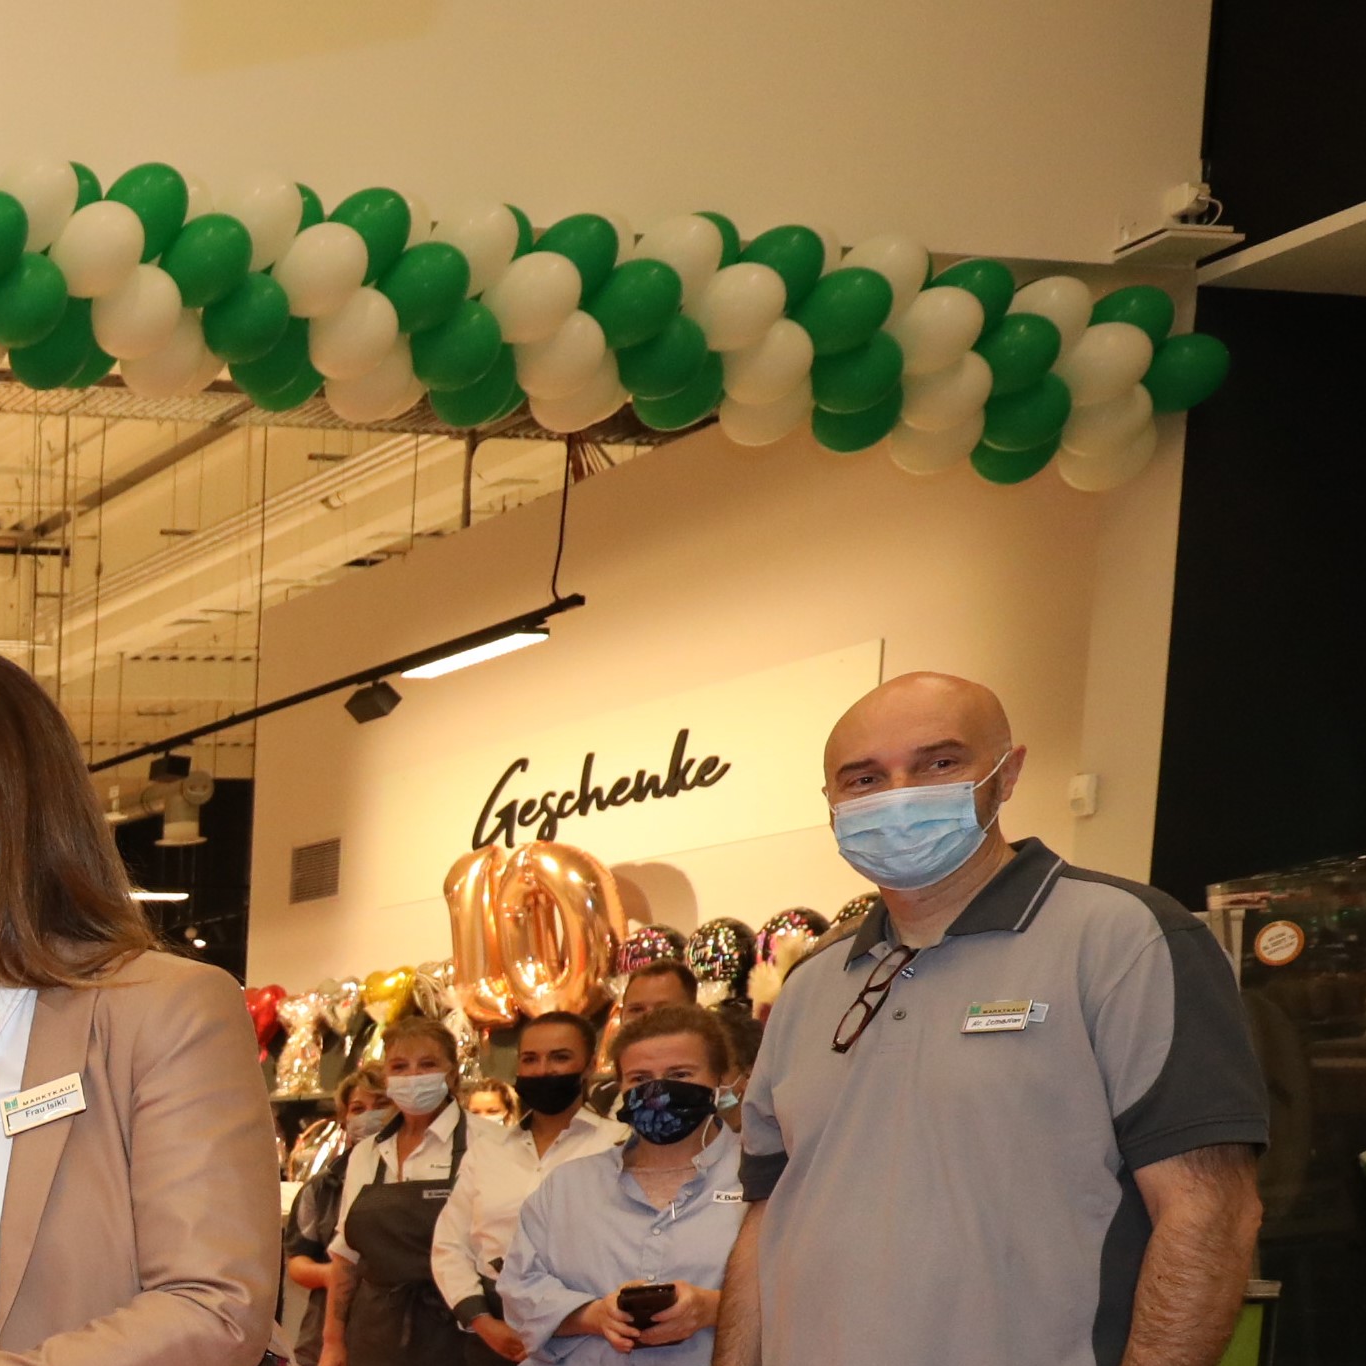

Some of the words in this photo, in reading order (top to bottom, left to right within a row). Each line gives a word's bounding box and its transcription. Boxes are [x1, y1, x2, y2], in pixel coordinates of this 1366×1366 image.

[472, 728, 732, 851] Geschenke
[443, 839, 628, 1027] 10
[22, 1083, 76, 1106] MARKTKAUF
[25, 1106, 45, 1118] Frau
[716, 1193, 742, 1201] K.Ban
